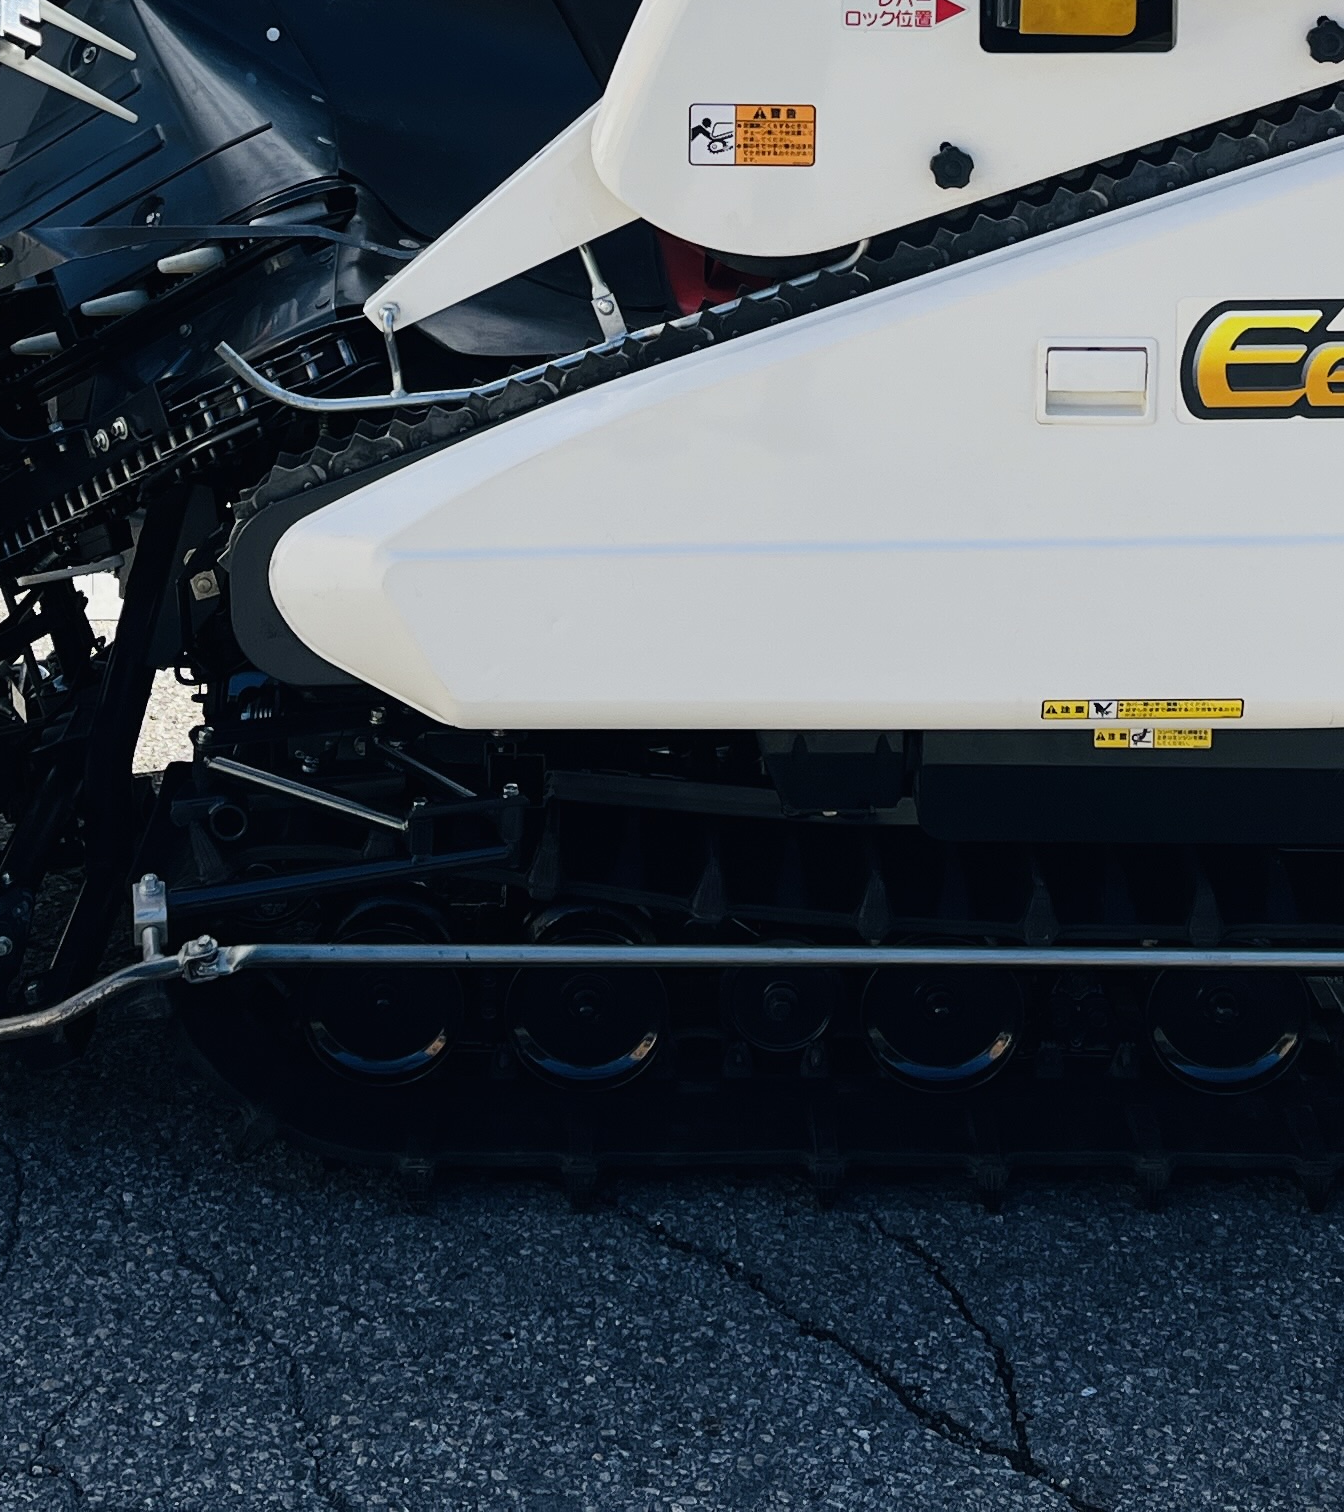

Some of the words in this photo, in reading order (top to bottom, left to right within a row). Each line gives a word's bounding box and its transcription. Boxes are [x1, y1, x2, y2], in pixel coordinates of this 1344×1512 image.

[845, 9, 933, 28] ロック位置
